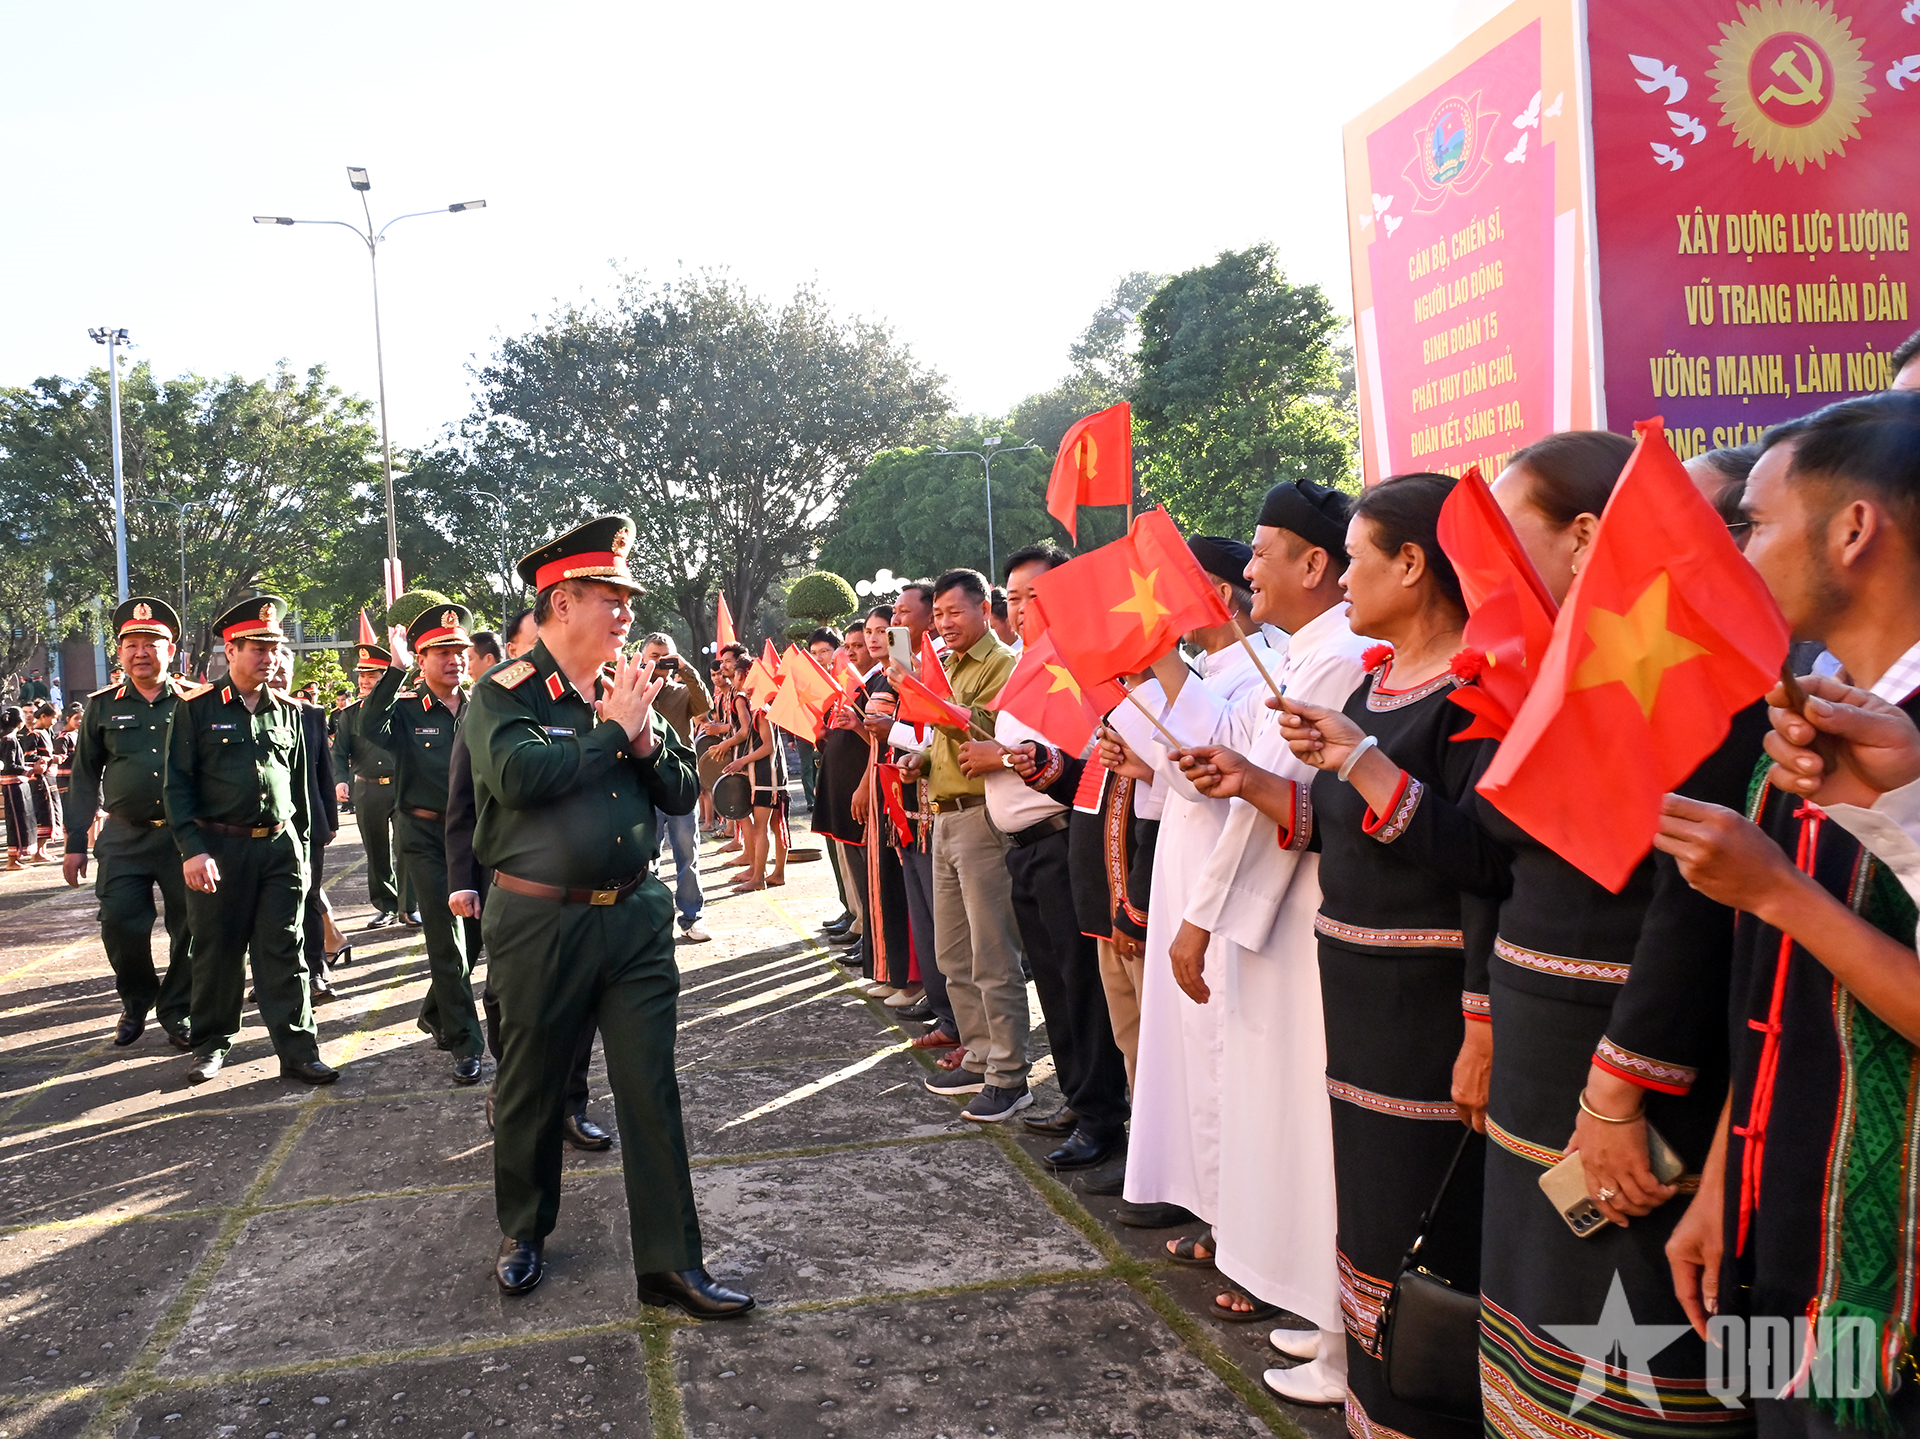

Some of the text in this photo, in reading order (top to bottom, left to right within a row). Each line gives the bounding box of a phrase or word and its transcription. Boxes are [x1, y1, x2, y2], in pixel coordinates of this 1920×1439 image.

[1408, 205, 1505, 281] CÁN BỘ, CHIẾN SĨ,
[1676, 205, 1909, 263] XÂY DỰNG LỰC LƯỢNG
[1414, 260, 1503, 324] NGƯỜI LAO ĐỘNG
[1684, 273, 1908, 326] VŨ TRANG NHÂN DÂN
[1423, 311, 1498, 365] BINH ĐOÀN 15
[1412, 345, 1517, 414] PHÁT HUY DÂN CHỦ,
[1649, 342, 1893, 404] VỮNG MẠNH, LÀM NÒN
[1411, 400, 1524, 458] ĐOÀN KẾT, SÁNG TẠO,
